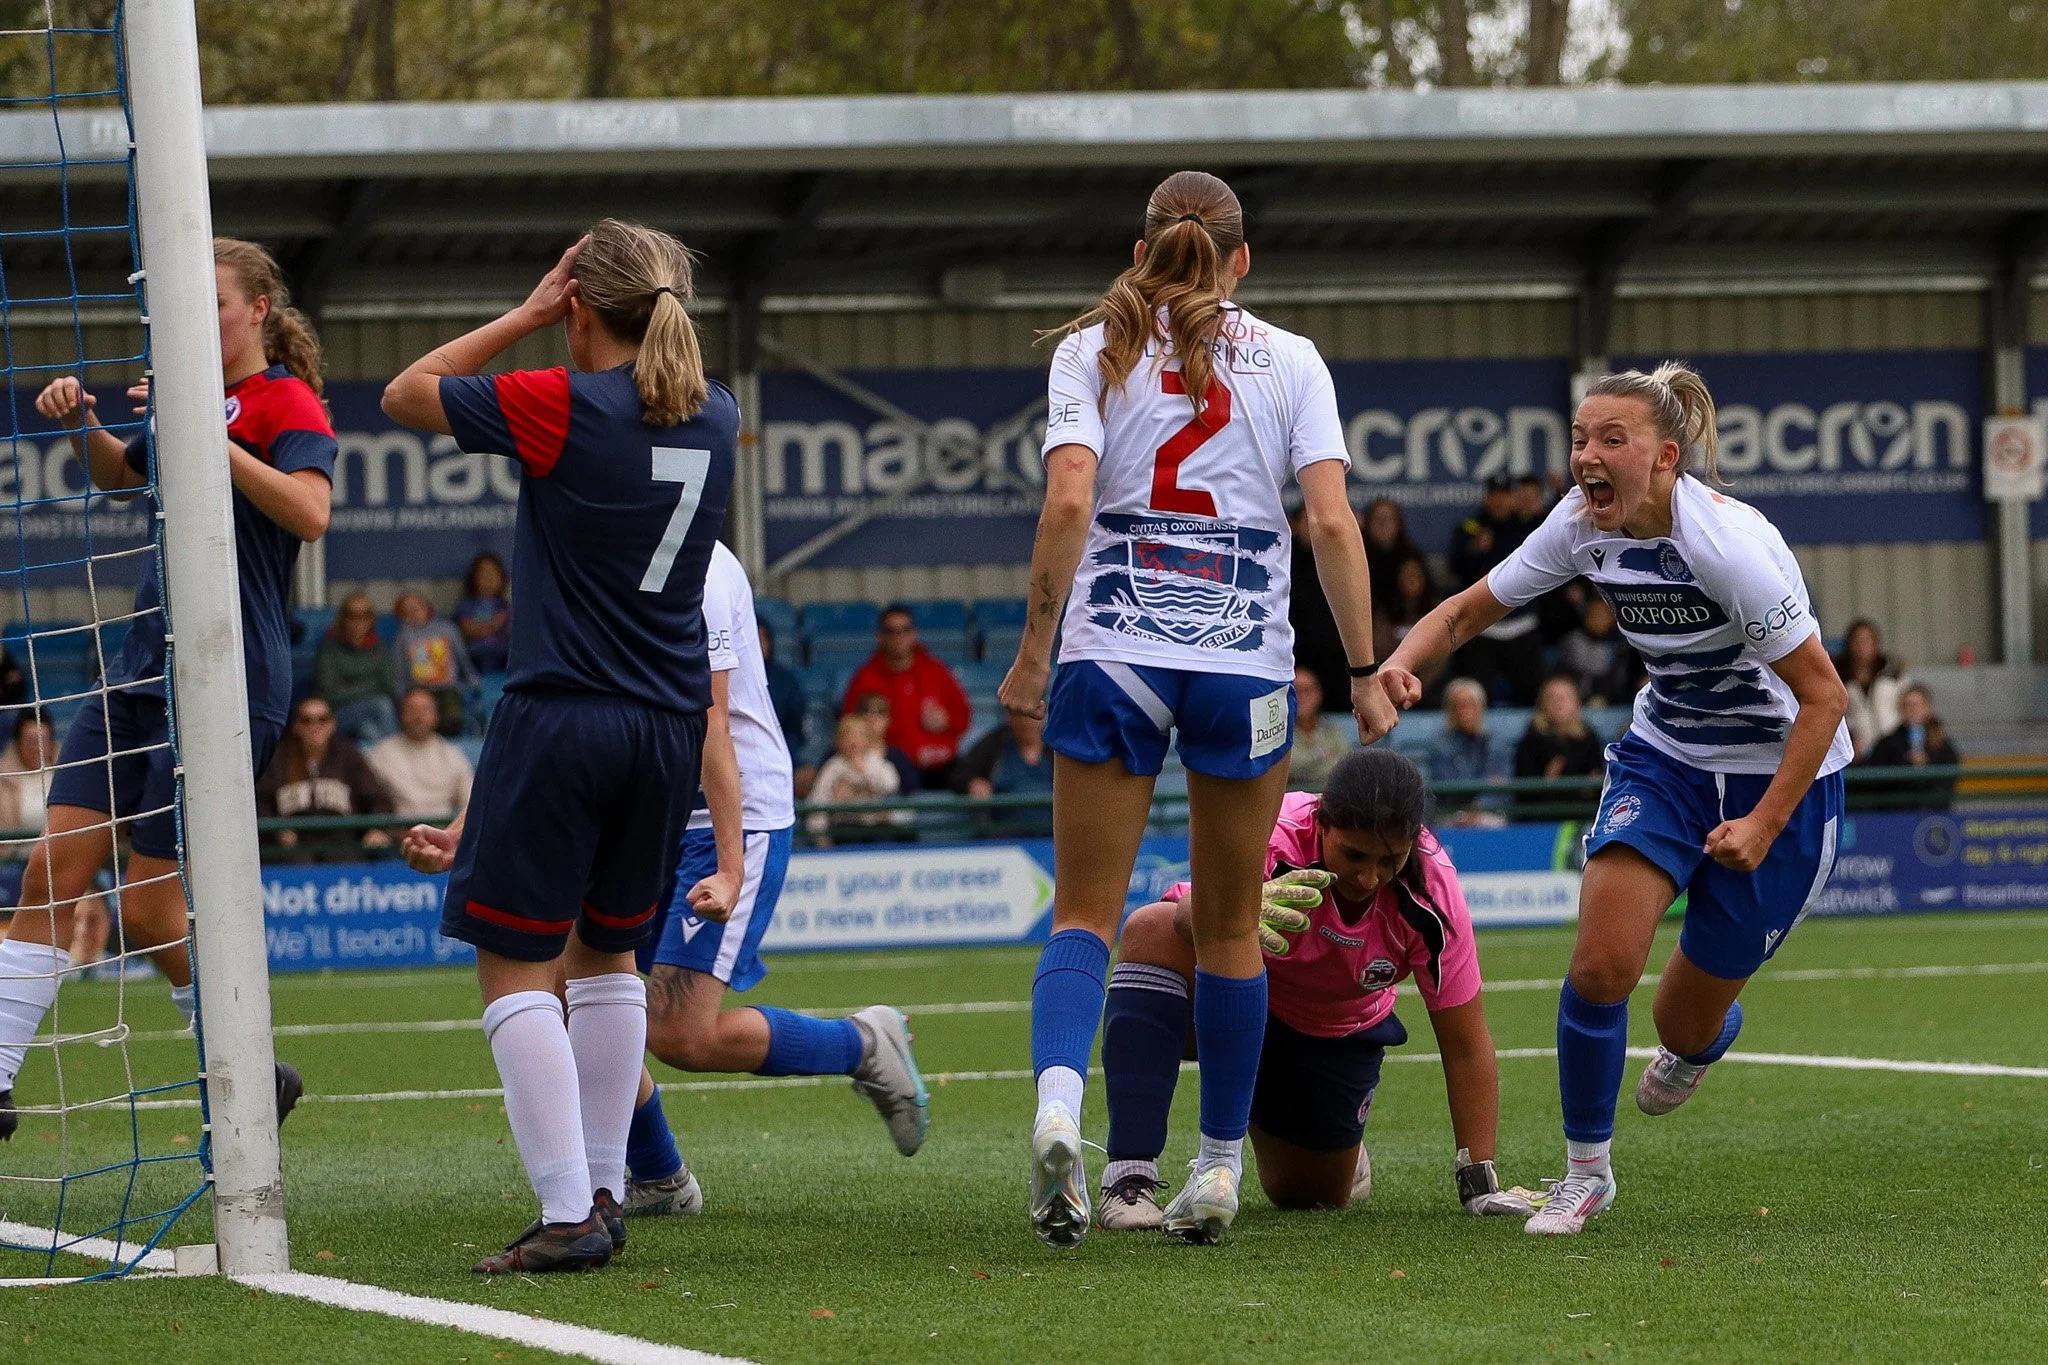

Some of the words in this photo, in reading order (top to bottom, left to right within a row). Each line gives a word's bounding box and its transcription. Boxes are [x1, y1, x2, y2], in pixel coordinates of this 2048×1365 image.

[1149, 371, 1231, 517] 2
[1348, 407, 1568, 481] cron
[1714, 400, 1971, 474] acron
[639, 446, 711, 593] 7
[1129, 522, 1168, 534] CIVITAS
[1170, 521, 1239, 532] OXONIENSIS
[1614, 592, 1667, 603] UNIVERSITY
[1670, 593, 1683, 603] OF
[1621, 605, 1710, 625] OXFORD
[323, 875, 438, 916] driven
[883, 898, 1012, 930] direction
[336, 919, 427, 958] teach
